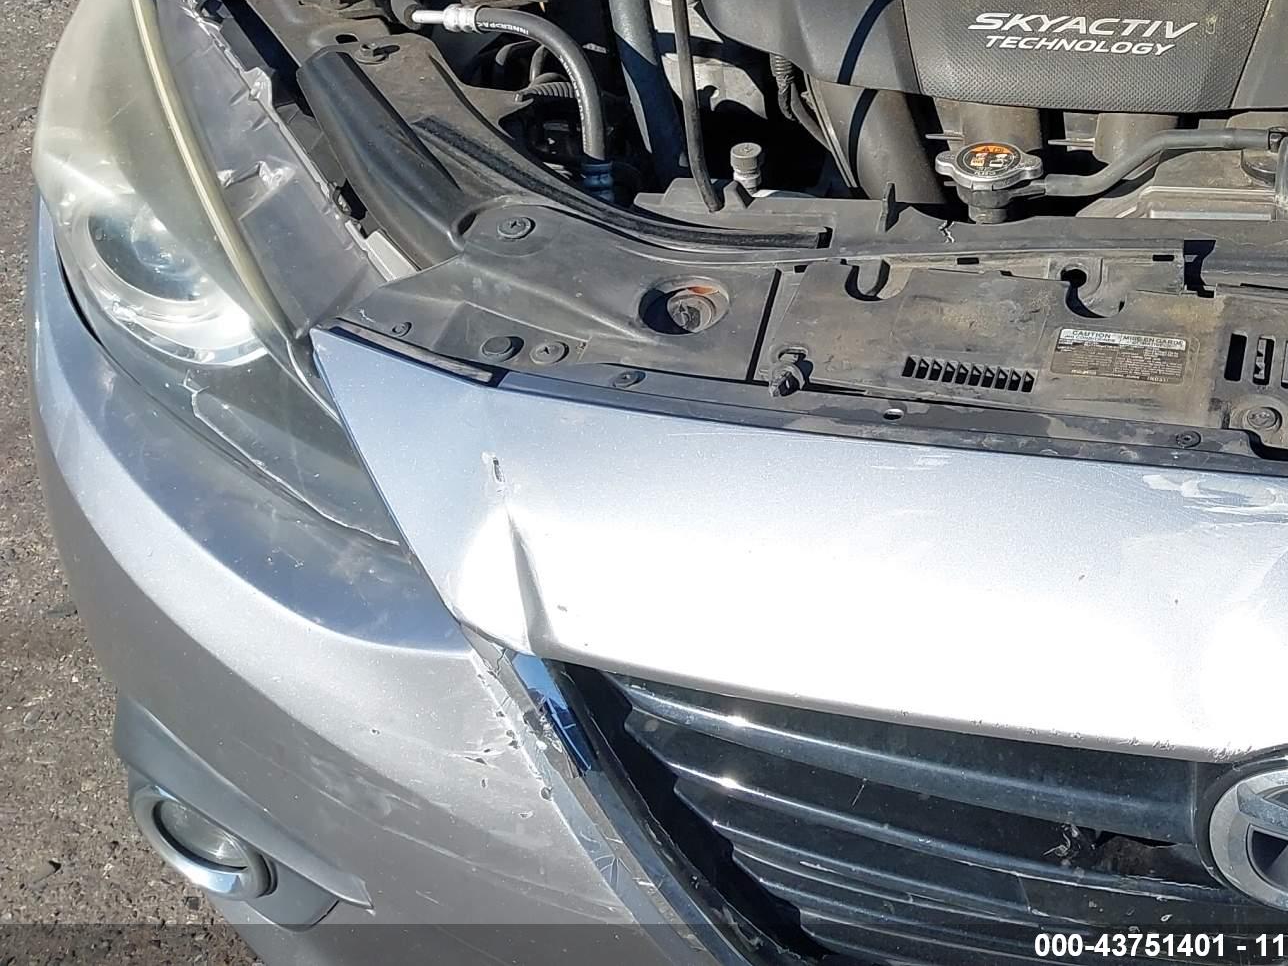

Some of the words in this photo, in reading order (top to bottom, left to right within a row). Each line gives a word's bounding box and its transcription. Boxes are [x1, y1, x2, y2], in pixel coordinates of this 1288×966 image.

[968, 12, 1198, 39] SKYACTIV
[985, 35, 1175, 56] TECHNOLOGY
[1073, 330, 1111, 339] CAUTION
